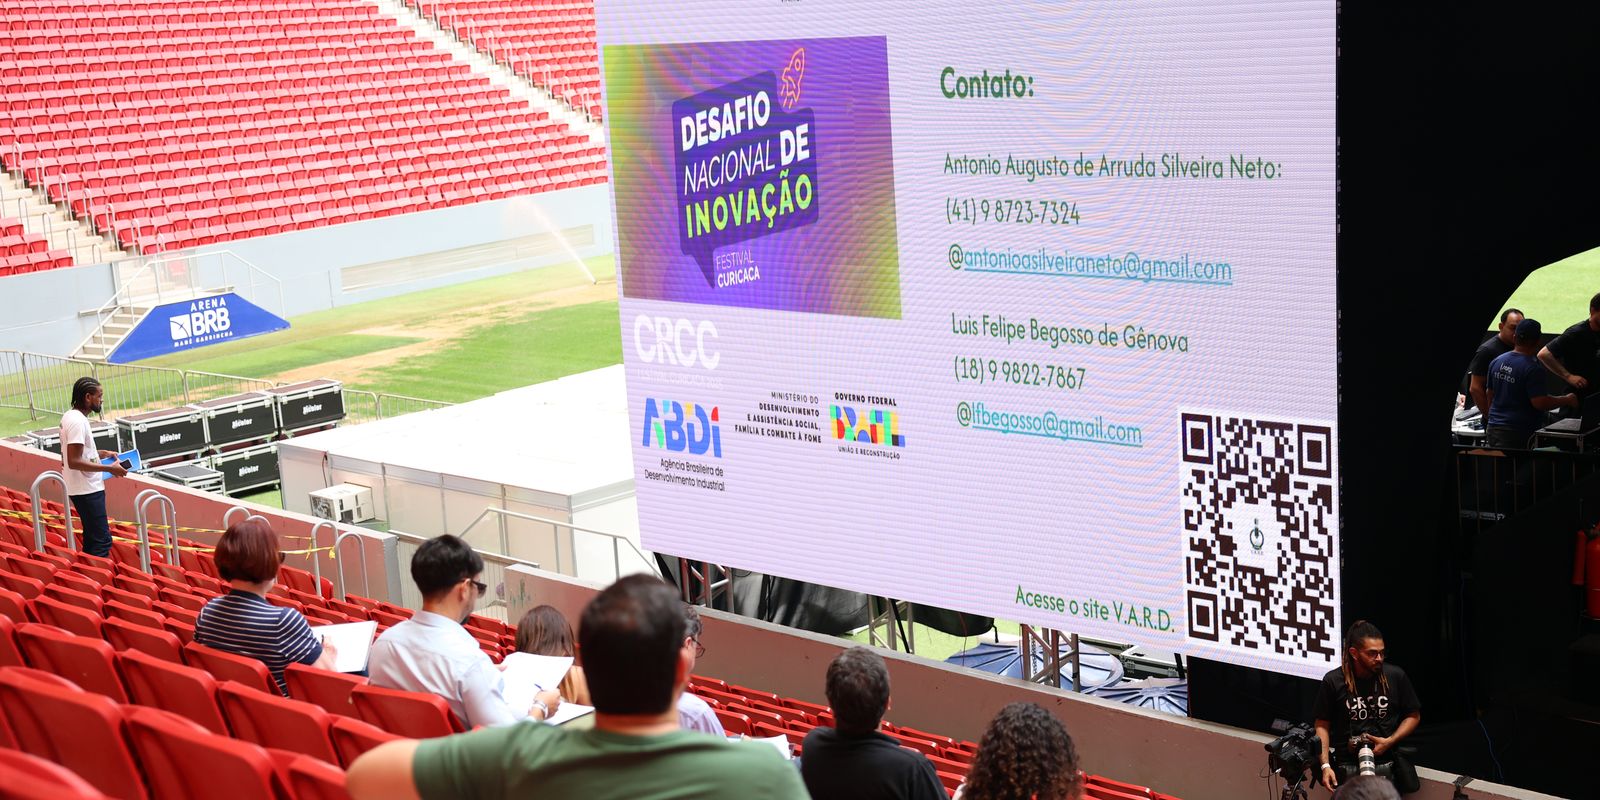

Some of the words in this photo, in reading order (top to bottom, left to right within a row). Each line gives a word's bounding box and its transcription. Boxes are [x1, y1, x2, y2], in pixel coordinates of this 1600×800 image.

[940, 66, 1034, 99] Contato:
[681, 90, 771, 152] DESAFIO
[684, 139, 775, 196] NACIONAL
[780, 123, 810, 166] DE
[944, 152, 1001, 177] Antonio
[1006, 152, 1069, 182] Augusto
[1073, 152, 1094, 177] de
[1099, 153, 1156, 178] Arruda
[1161, 153, 1223, 178] Silveira
[1229, 154, 1282, 180] Neto:
[686, 168, 813, 238] INOVAÇÃO
[946, 197, 976, 225] (41)
[981, 199, 990, 222] 9
[995, 199, 1081, 225] 8723-7324
[716, 249, 754, 271] FESTIVAL
[949, 244, 1233, 284] @antonioasilveiraneto@gmail.com
[717, 266, 760, 288] CURICACA
[190, 297, 226, 312] ARENA
[191, 307, 231, 336] BRB
[952, 312, 979, 336] Luis
[983, 314, 1026, 344] Felipe
[1030, 318, 1094, 349] Begosso
[1098, 322, 1118, 347] de
[1123, 325, 1189, 352] Gênova
[634, 314, 720, 370] CRCC
[954, 355, 984, 384] (18)
[988, 359, 997, 382] 9
[1002, 361, 1086, 390] 9822-7867
[759, 402, 820, 417] DESENVOLVIMENTO
[771, 391, 808, 403] MINISTÉRIO
[810, 396, 819, 404] DO
[835, 392, 865, 403] GOVERNO
[868, 396, 897, 406] FEDERAL
[735, 424, 759, 435] FAMÍLIA
[761, 428, 765, 436] E
[767, 428, 796, 440] COMBATE
[804, 434, 822, 443] FOME
[747, 413, 751, 421] E
[753, 414, 793, 427] ASSISTÊNCIA
[795, 420, 821, 431] SOCIAL,
[957, 401, 1143, 446] @lfbegosso@gmail.com
[838, 445, 854, 454] UNIÃO
[860, 448, 901, 460] RECONSTRUÇÃO
[644, 469, 695, 487] Desenvolvimento
[696, 479, 725, 491] Industrial
[660, 458, 685, 471] Agência
[686, 461, 714, 476] Brasileira
[715, 466, 724, 477] de
[1015, 584, 1065, 613] Acesse
[1069, 600, 1079, 615] o
[1083, 598, 1109, 621] site
[1113, 600, 1175, 633] V.A.R.D.
[1350, 708, 1387, 720] 205
